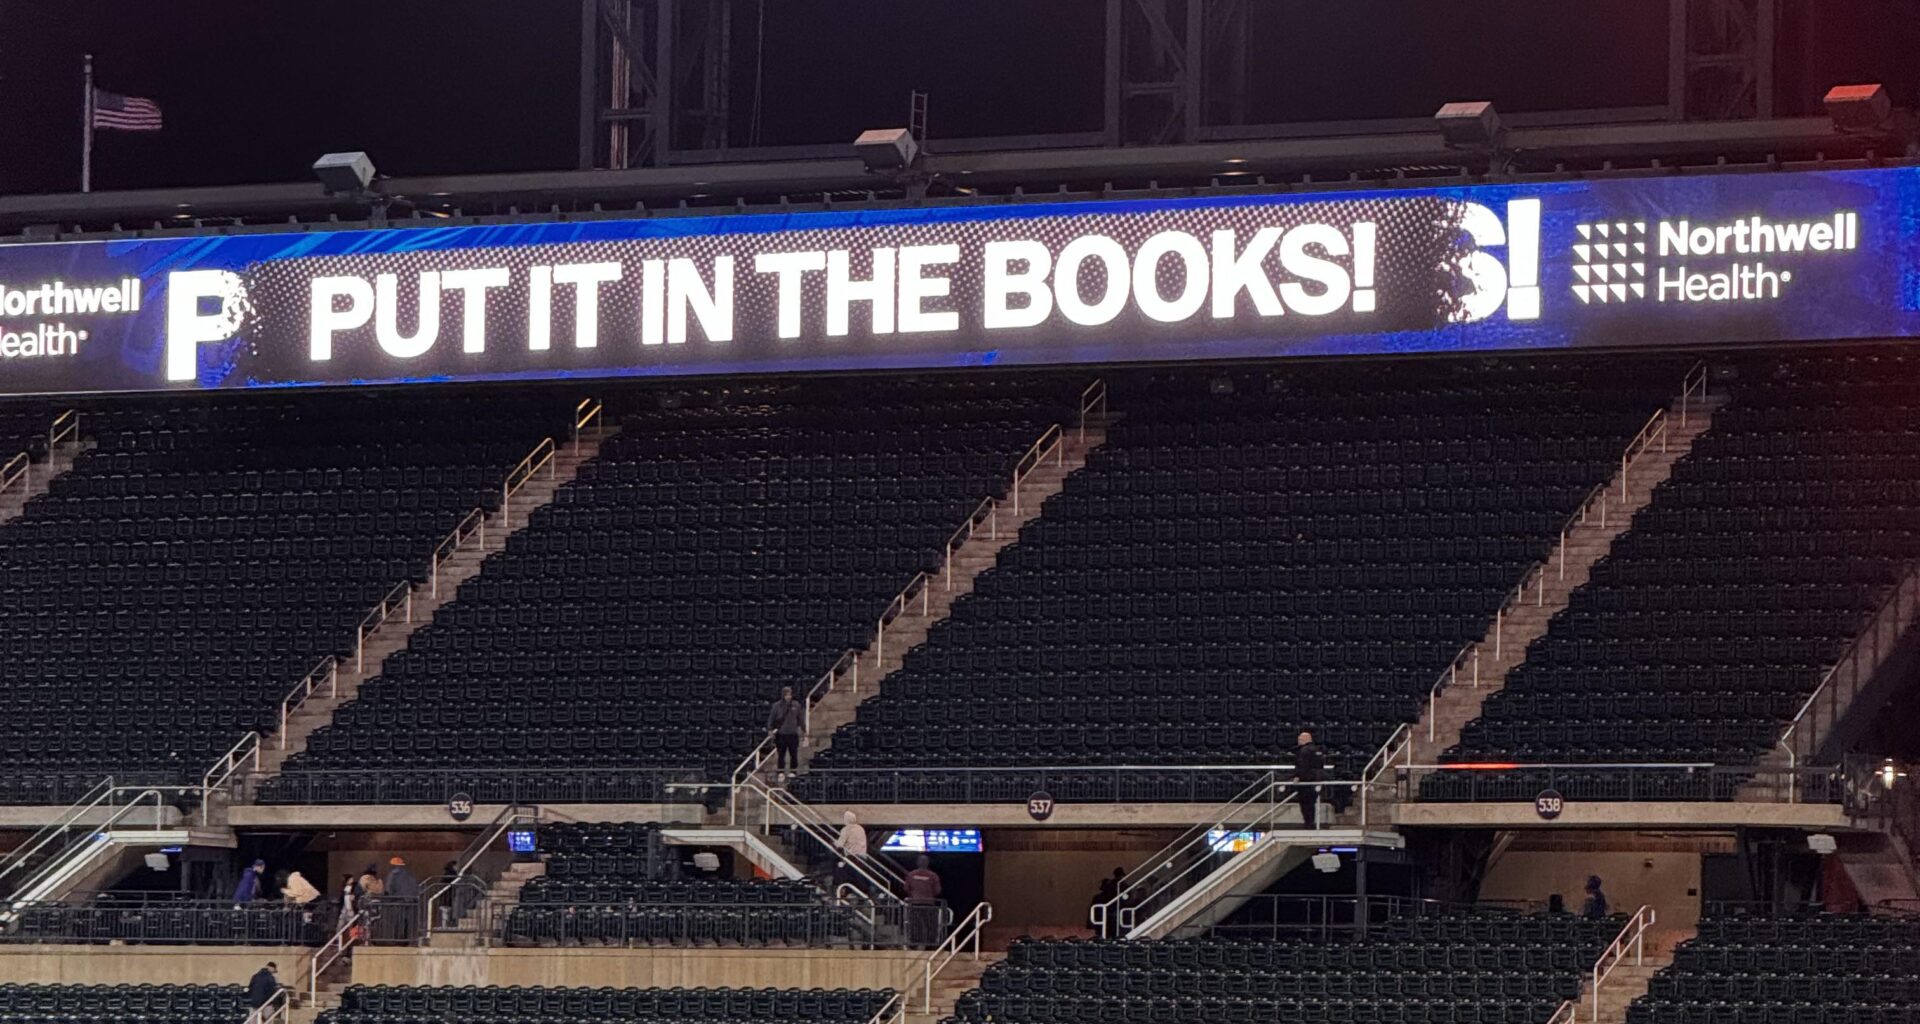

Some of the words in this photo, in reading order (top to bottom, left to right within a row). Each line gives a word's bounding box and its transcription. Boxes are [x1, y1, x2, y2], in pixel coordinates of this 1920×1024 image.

[1659, 213, 1856, 256] Northwell
[0, 278, 140, 316] orthwell
[310, 264, 510, 361] PUT
[529, 261, 622, 350] IT
[642, 255, 735, 345] IN
[754, 243, 960, 339] THE
[984, 221, 1376, 329] BOOKS!
[0, 322, 78, 357] ealth
[451, 801, 471, 814] 536
[1030, 800, 1051, 813] 537
[1538, 798, 1560, 812] 538
